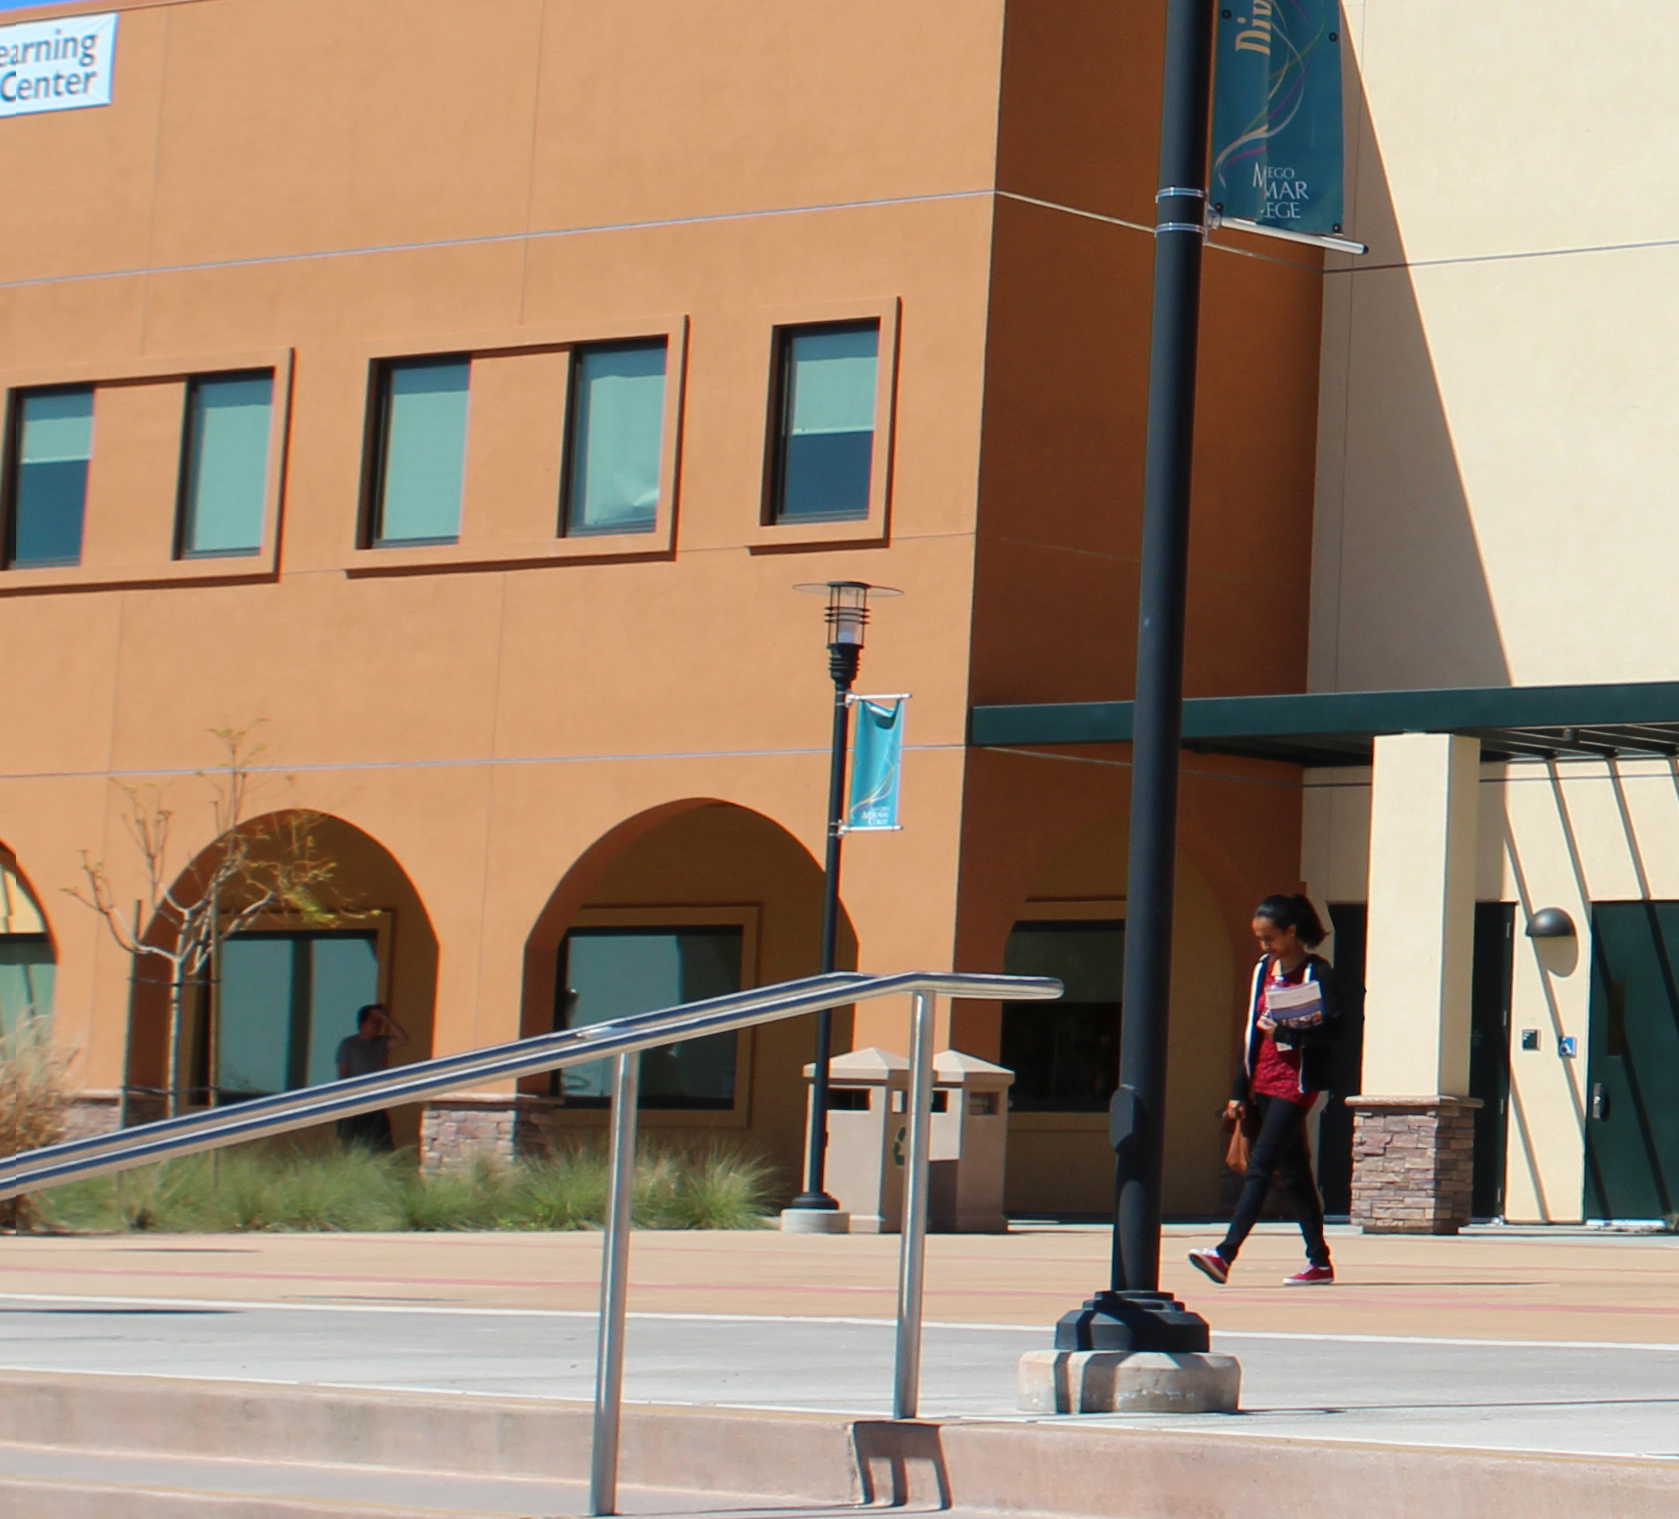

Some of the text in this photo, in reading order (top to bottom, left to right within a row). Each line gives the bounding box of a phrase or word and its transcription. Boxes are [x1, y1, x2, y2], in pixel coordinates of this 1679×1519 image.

[0, 28, 97, 67] earning
[0, 70, 98, 103] Center
[1268, 167, 1295, 179] EGO
